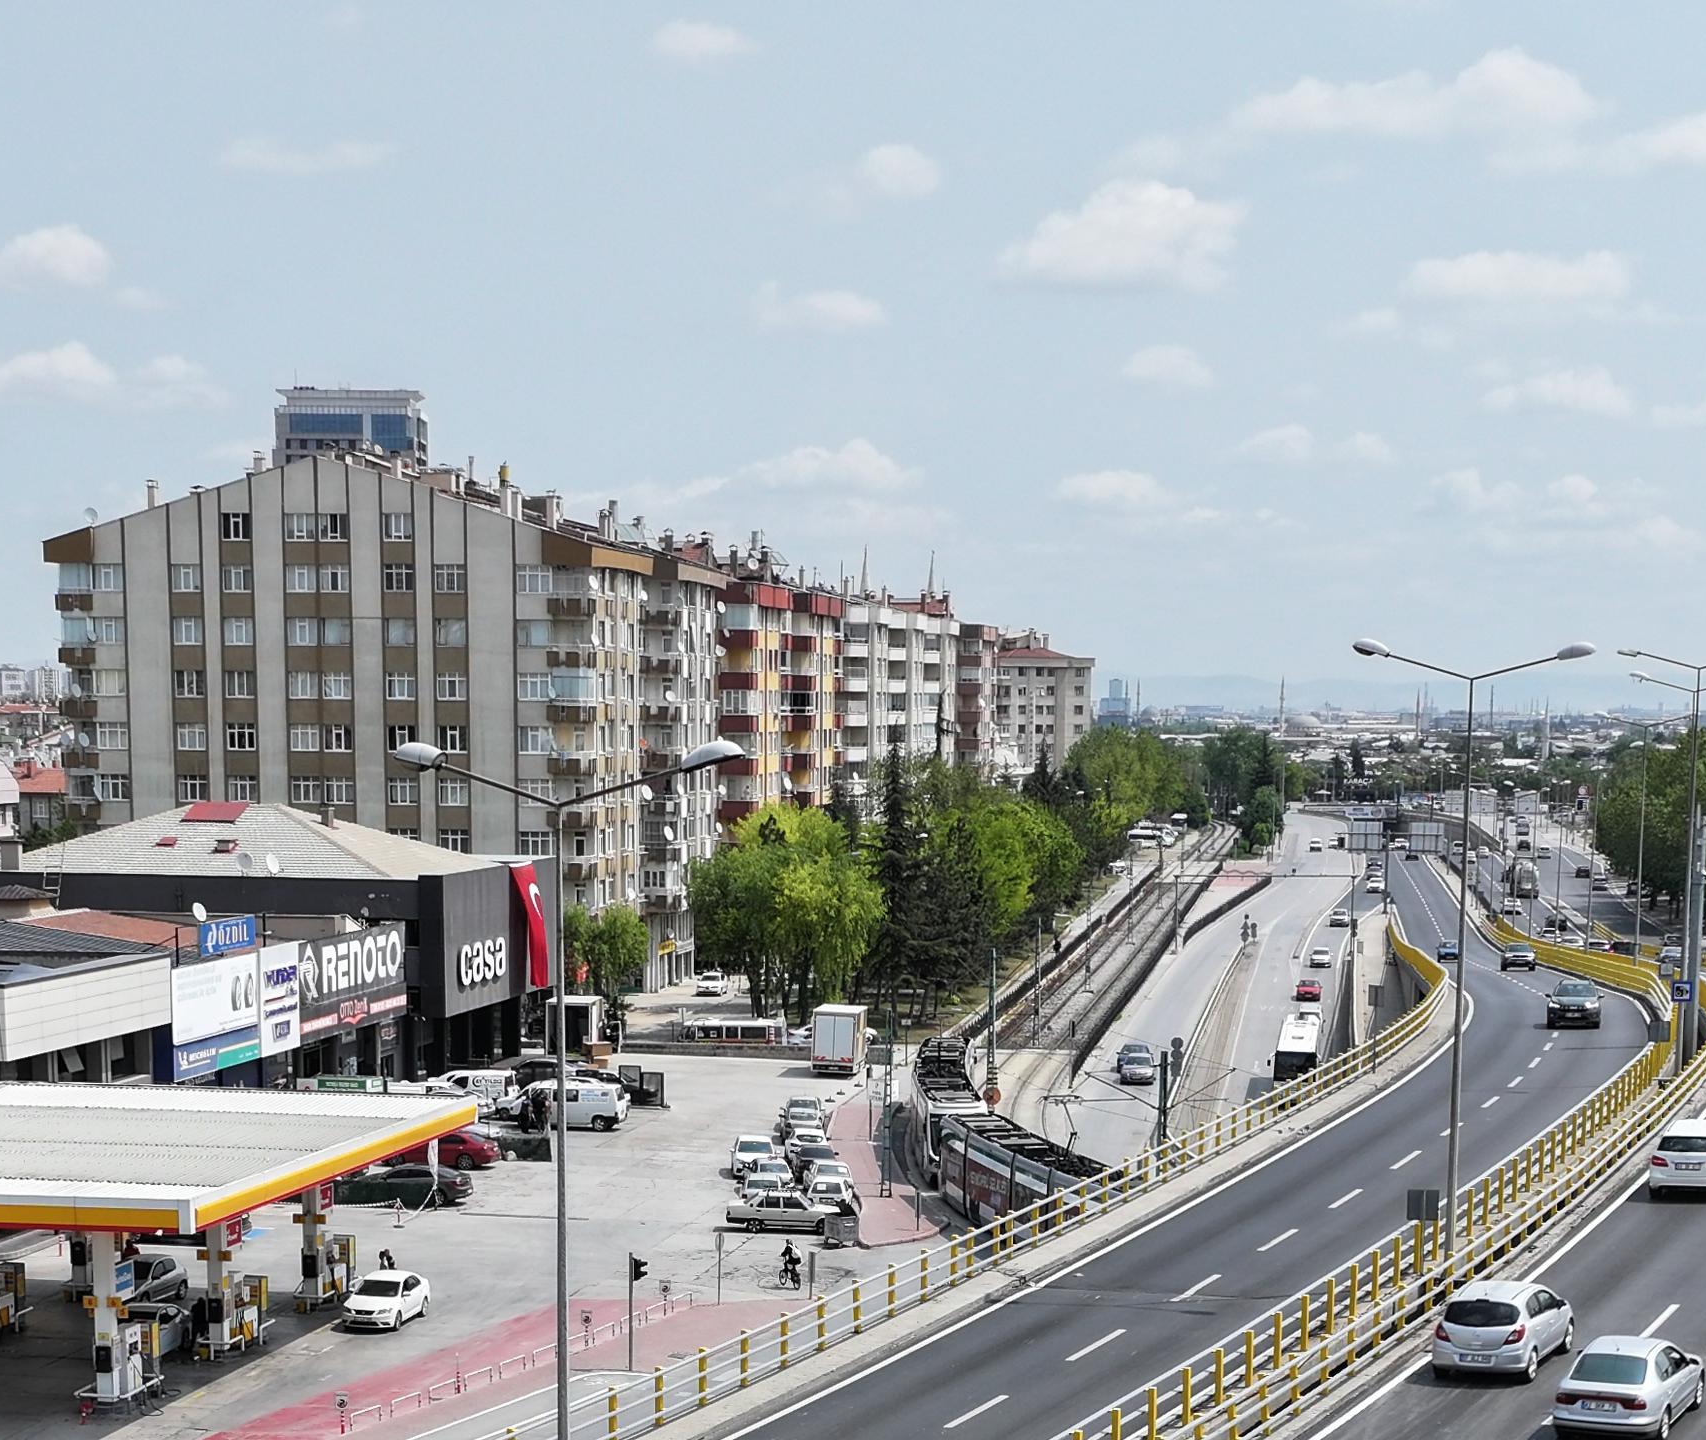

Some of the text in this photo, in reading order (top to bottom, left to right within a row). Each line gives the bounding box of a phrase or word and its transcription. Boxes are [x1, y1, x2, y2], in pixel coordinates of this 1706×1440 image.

[218, 922, 250, 946] ÖZDİL
[322, 930, 402, 994] RENOTO
[460, 936, 507, 986] casa
